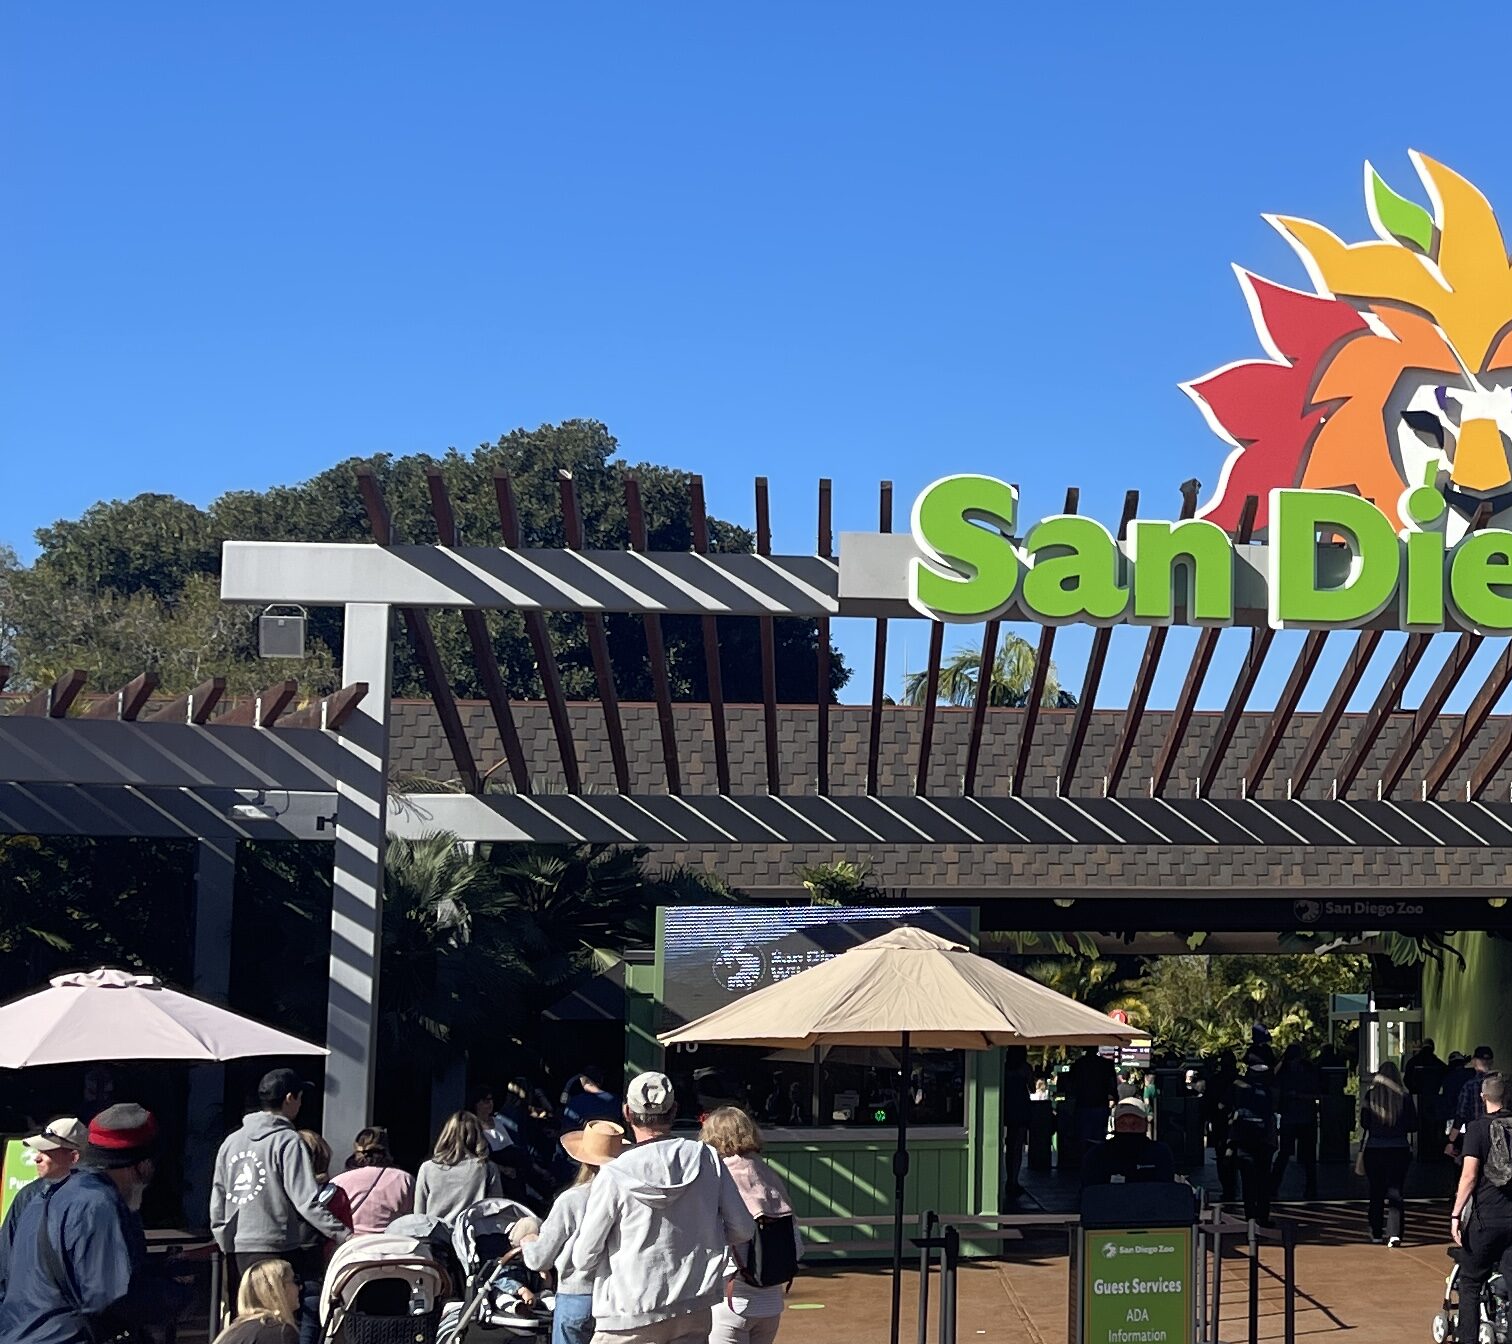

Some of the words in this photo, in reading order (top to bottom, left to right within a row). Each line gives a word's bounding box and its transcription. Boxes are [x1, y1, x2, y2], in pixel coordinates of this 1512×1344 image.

[910, 474, 1235, 624] San
[1325, 902, 1352, 914] San
[1354, 901, 1395, 917] Diego
[1396, 902, 1424, 914] Zoo
[1119, 1245, 1135, 1254] San
[1135, 1245, 1158, 1255] Diego
[1158, 1245, 1175, 1253] Zoo
[1094, 1278, 1130, 1295] Guest
[1132, 1276, 1182, 1294] Services
[1126, 1308, 1150, 1322] ADA
[1108, 1328, 1167, 1343] Information
